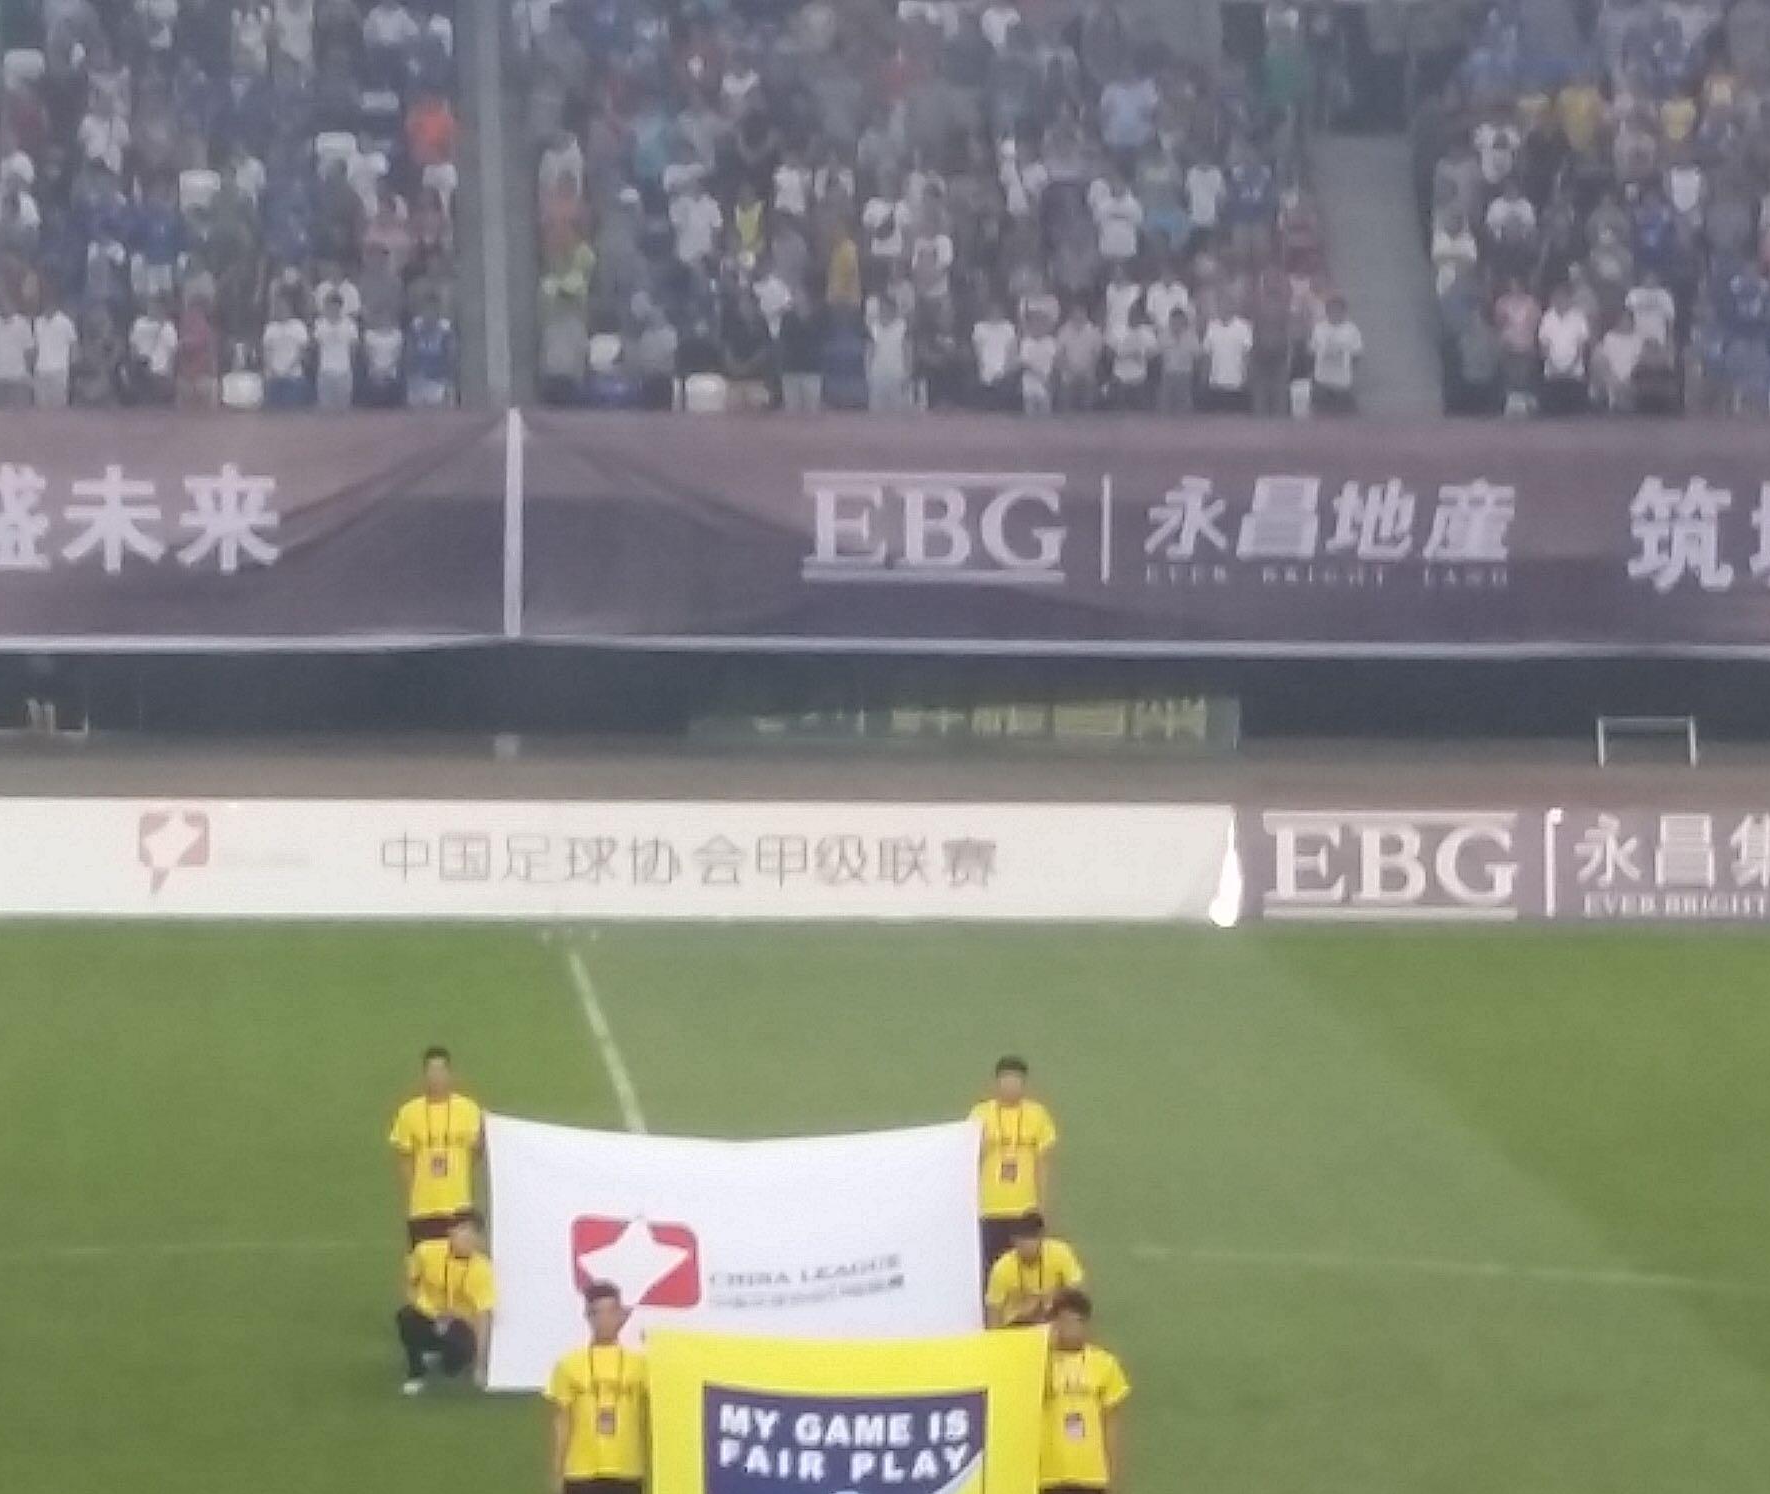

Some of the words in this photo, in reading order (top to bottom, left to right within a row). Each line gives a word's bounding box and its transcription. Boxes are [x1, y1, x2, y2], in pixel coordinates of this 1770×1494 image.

[807, 485, 1065, 568] EBG
[381, 832, 999, 888] 中国足球协会甲级联赛
[1266, 822, 1519, 904] EBG
[719, 1403, 780, 1440] MY
[794, 1412, 914, 1448] GAME
[928, 1408, 970, 1446] IS
[719, 1438, 826, 1484] FAIR
[849, 1442, 970, 1484] PLAY
